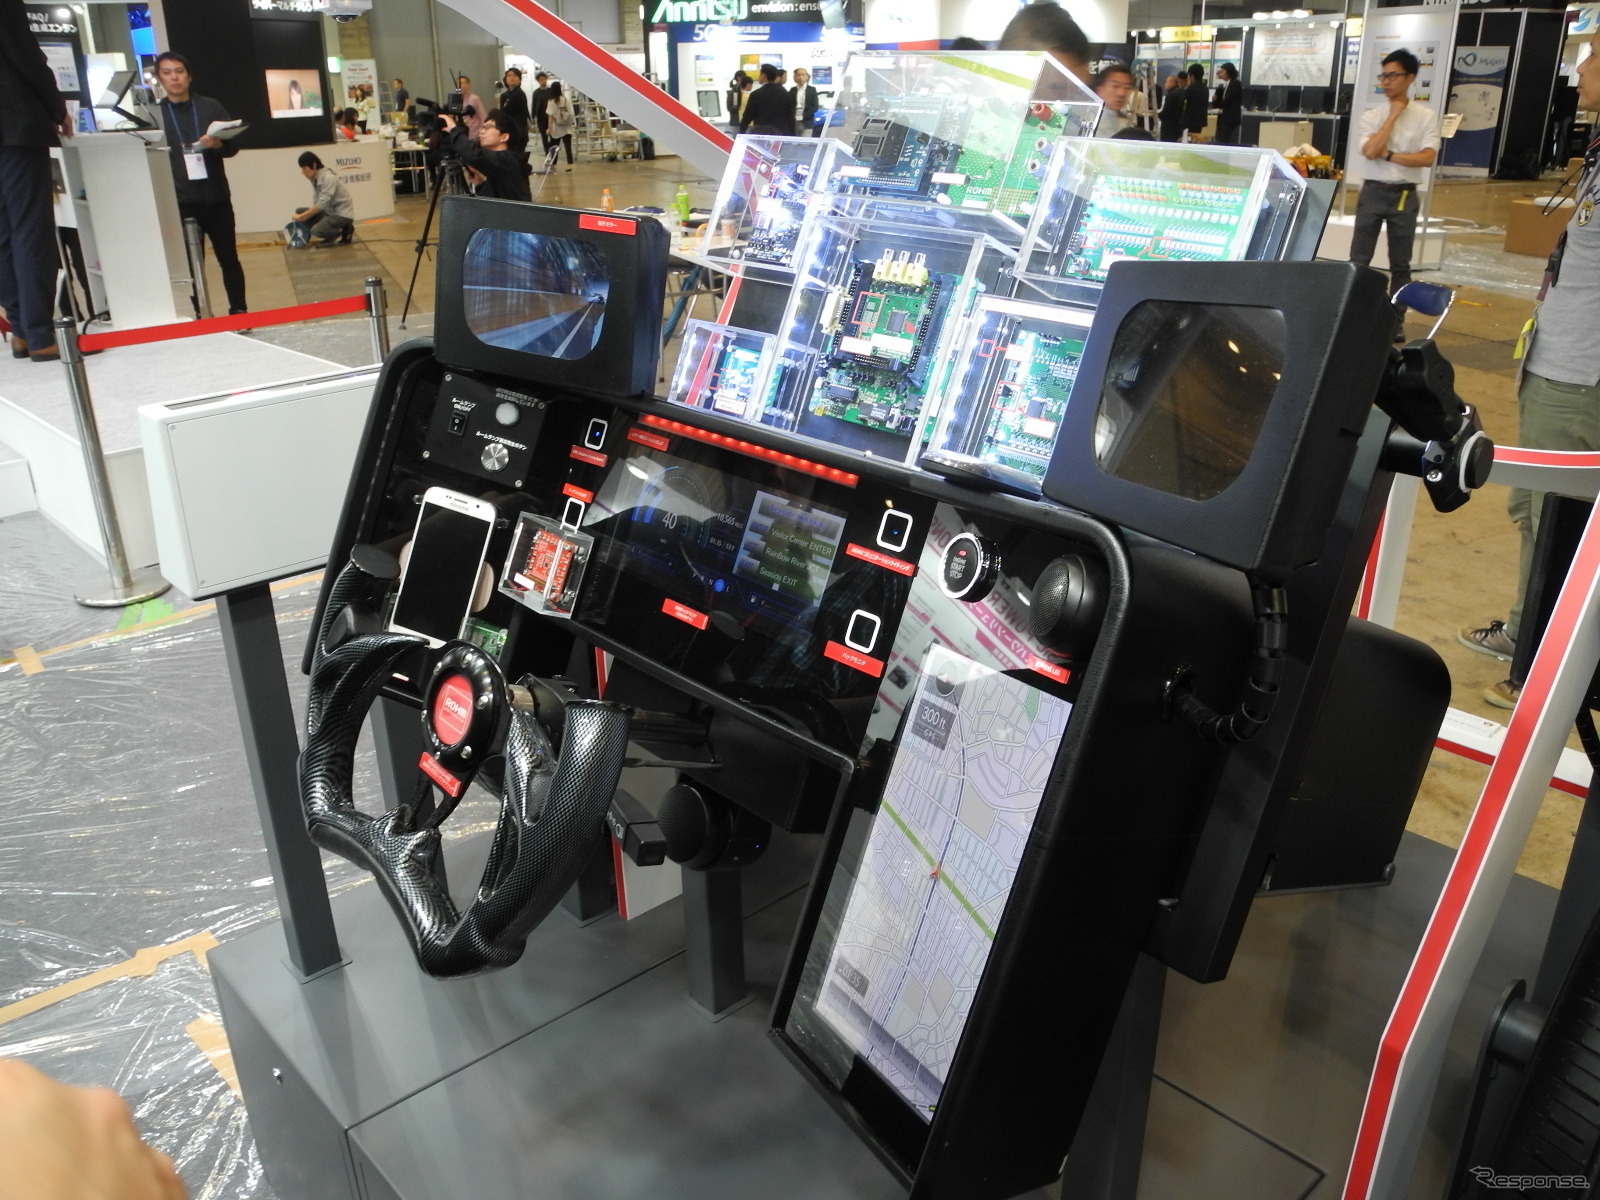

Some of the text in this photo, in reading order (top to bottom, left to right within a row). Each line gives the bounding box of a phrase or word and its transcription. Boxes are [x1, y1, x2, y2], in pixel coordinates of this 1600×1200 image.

[651, 0, 748, 24] Anritsu
[1479, 57, 1506, 69] Mugen
[336, 156, 362, 166] MIZUHO
[965, 186, 993, 196] ROHM
[662, 510, 678, 529] 40
[717, 513, 736, 527] 10,565
[768, 503, 828, 532] Seaside Highway
[789, 535, 808, 547] Center
[808, 540, 833, 556] ENTER
[790, 555, 807, 569] River
[949, 562, 966, 573] START
[781, 576, 798, 587] EXIT
[949, 569, 963, 580] STOP
[445, 696, 468, 720] ROHM
[921, 706, 947, 730] 300 ft
[923, 728, 937, 741] GPS
